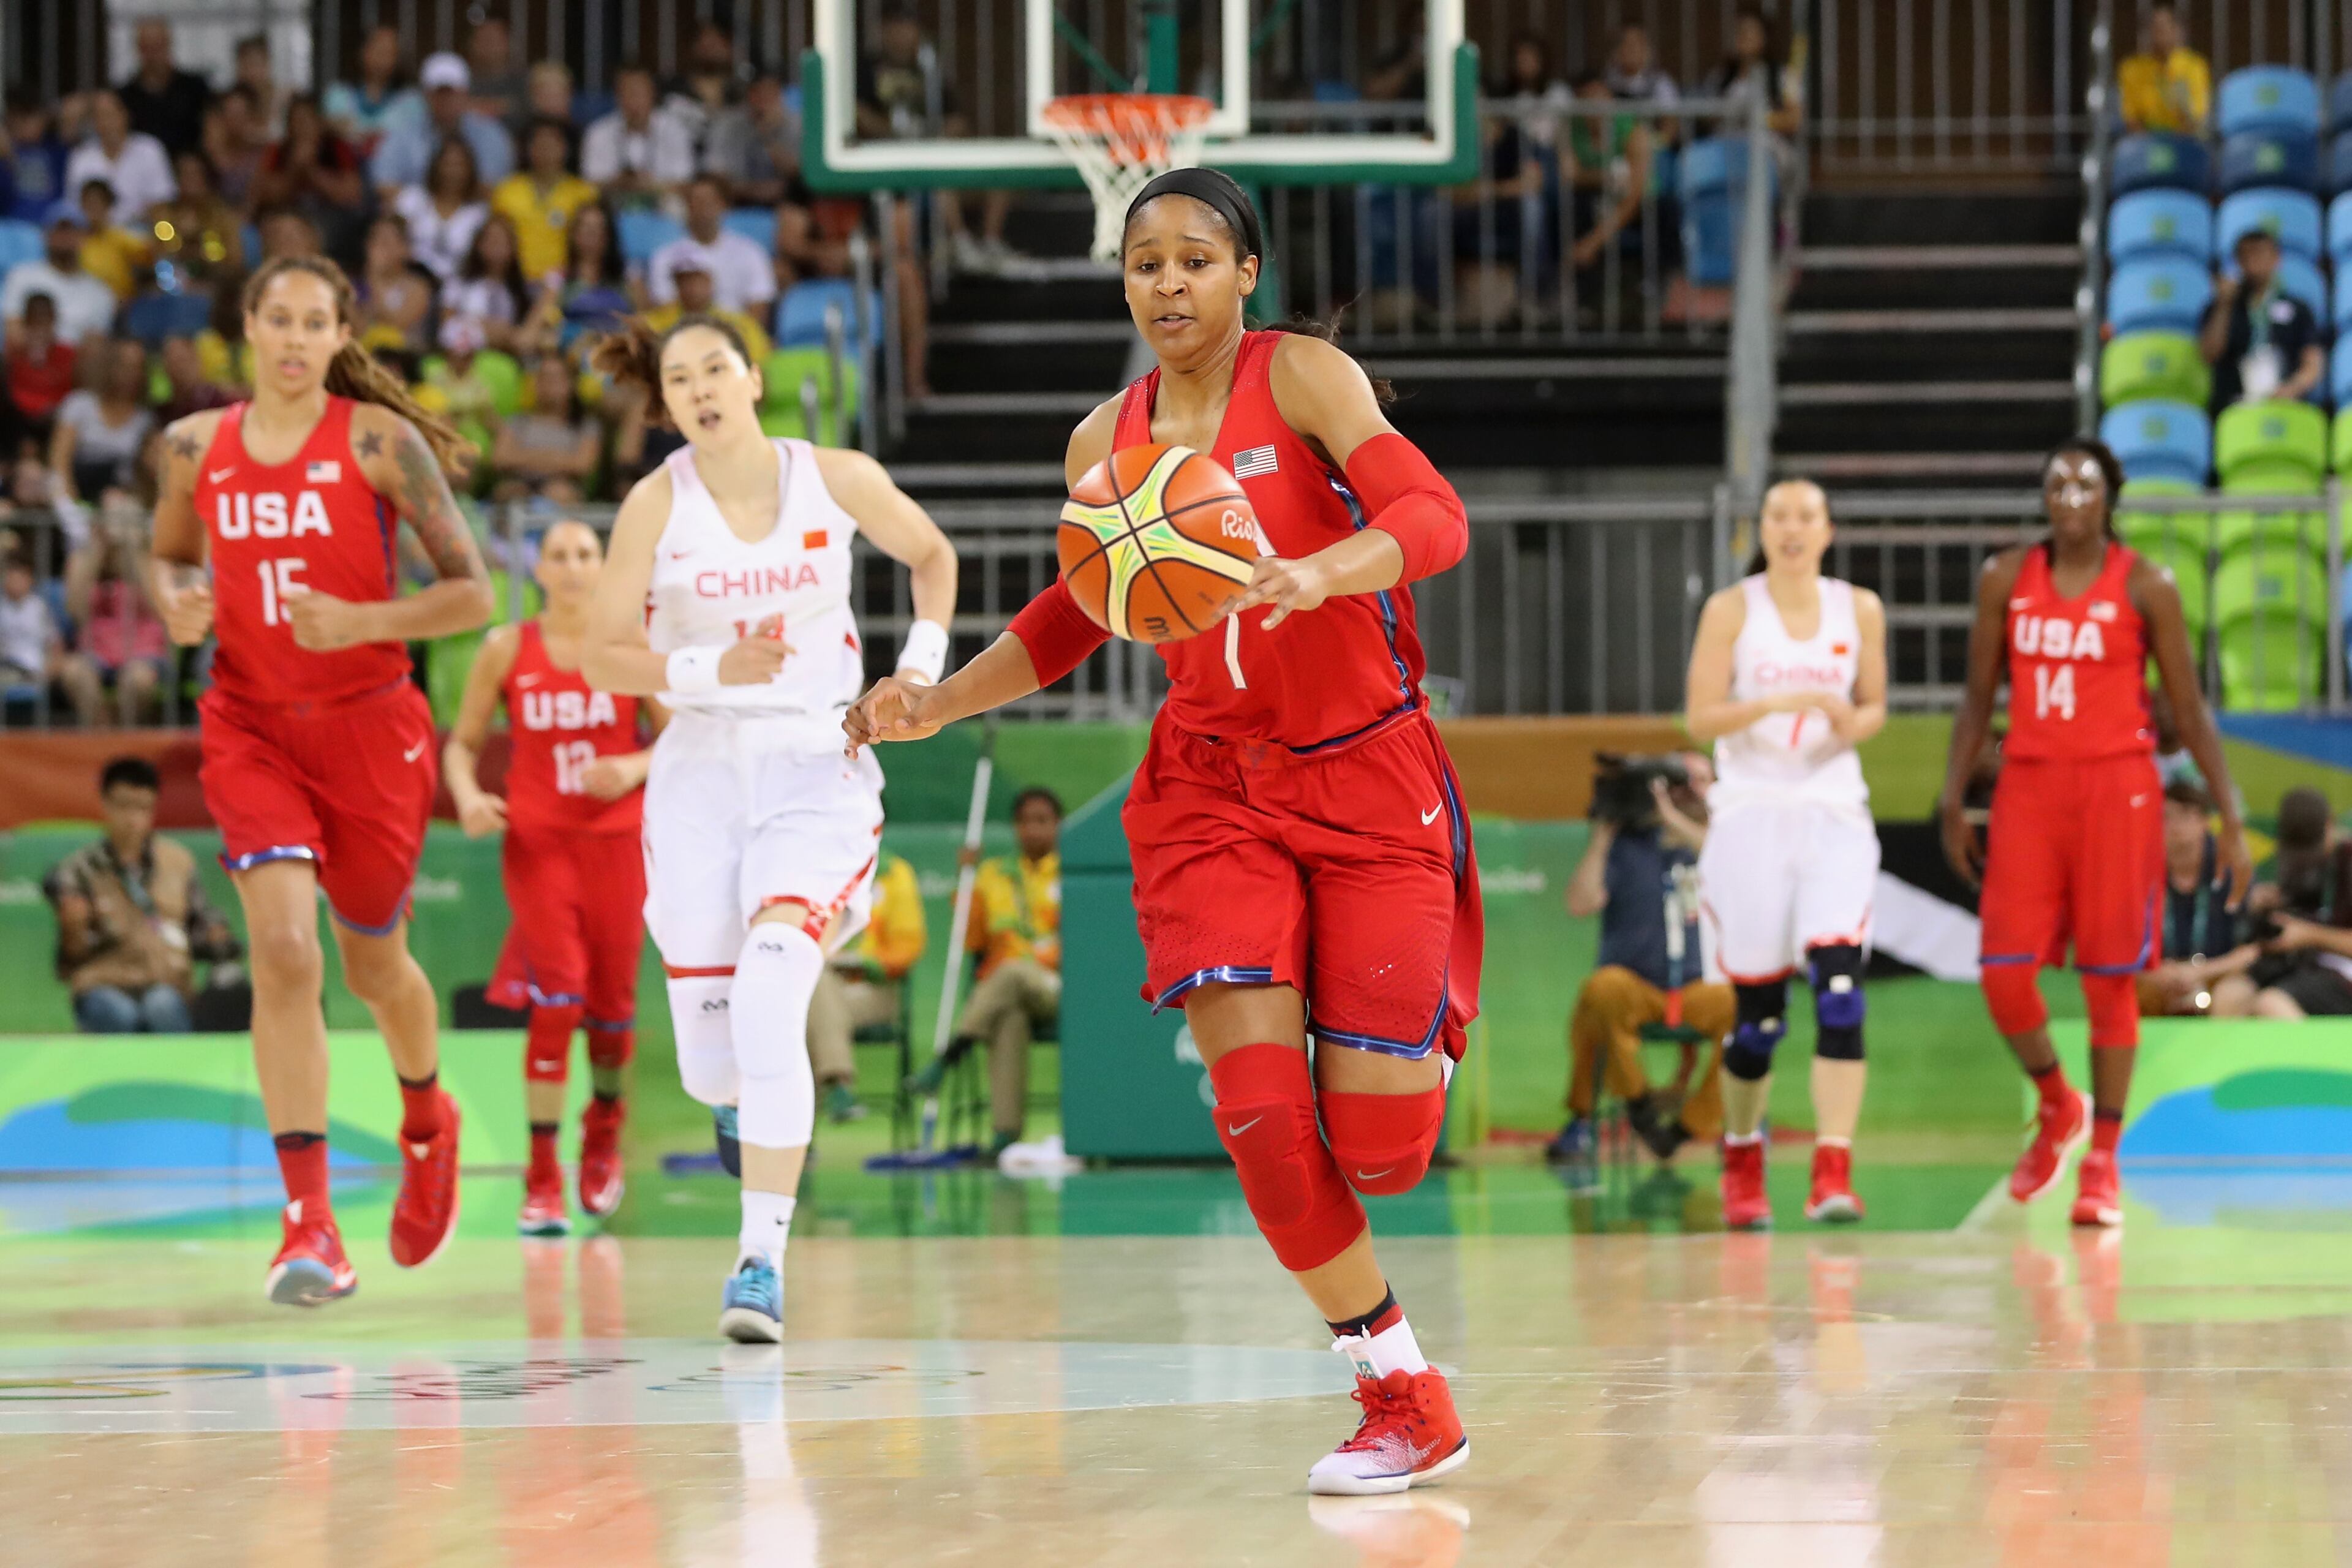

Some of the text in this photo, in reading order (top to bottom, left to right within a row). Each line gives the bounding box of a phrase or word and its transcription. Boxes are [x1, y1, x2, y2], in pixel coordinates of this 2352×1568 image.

[217, 490, 333, 540] USA
[257, 556, 311, 627] 15
[696, 562, 820, 598] CHINA
[2015, 614, 2106, 660] USA
[522, 690, 618, 731] USA
[2034, 663, 2076, 721] 14
